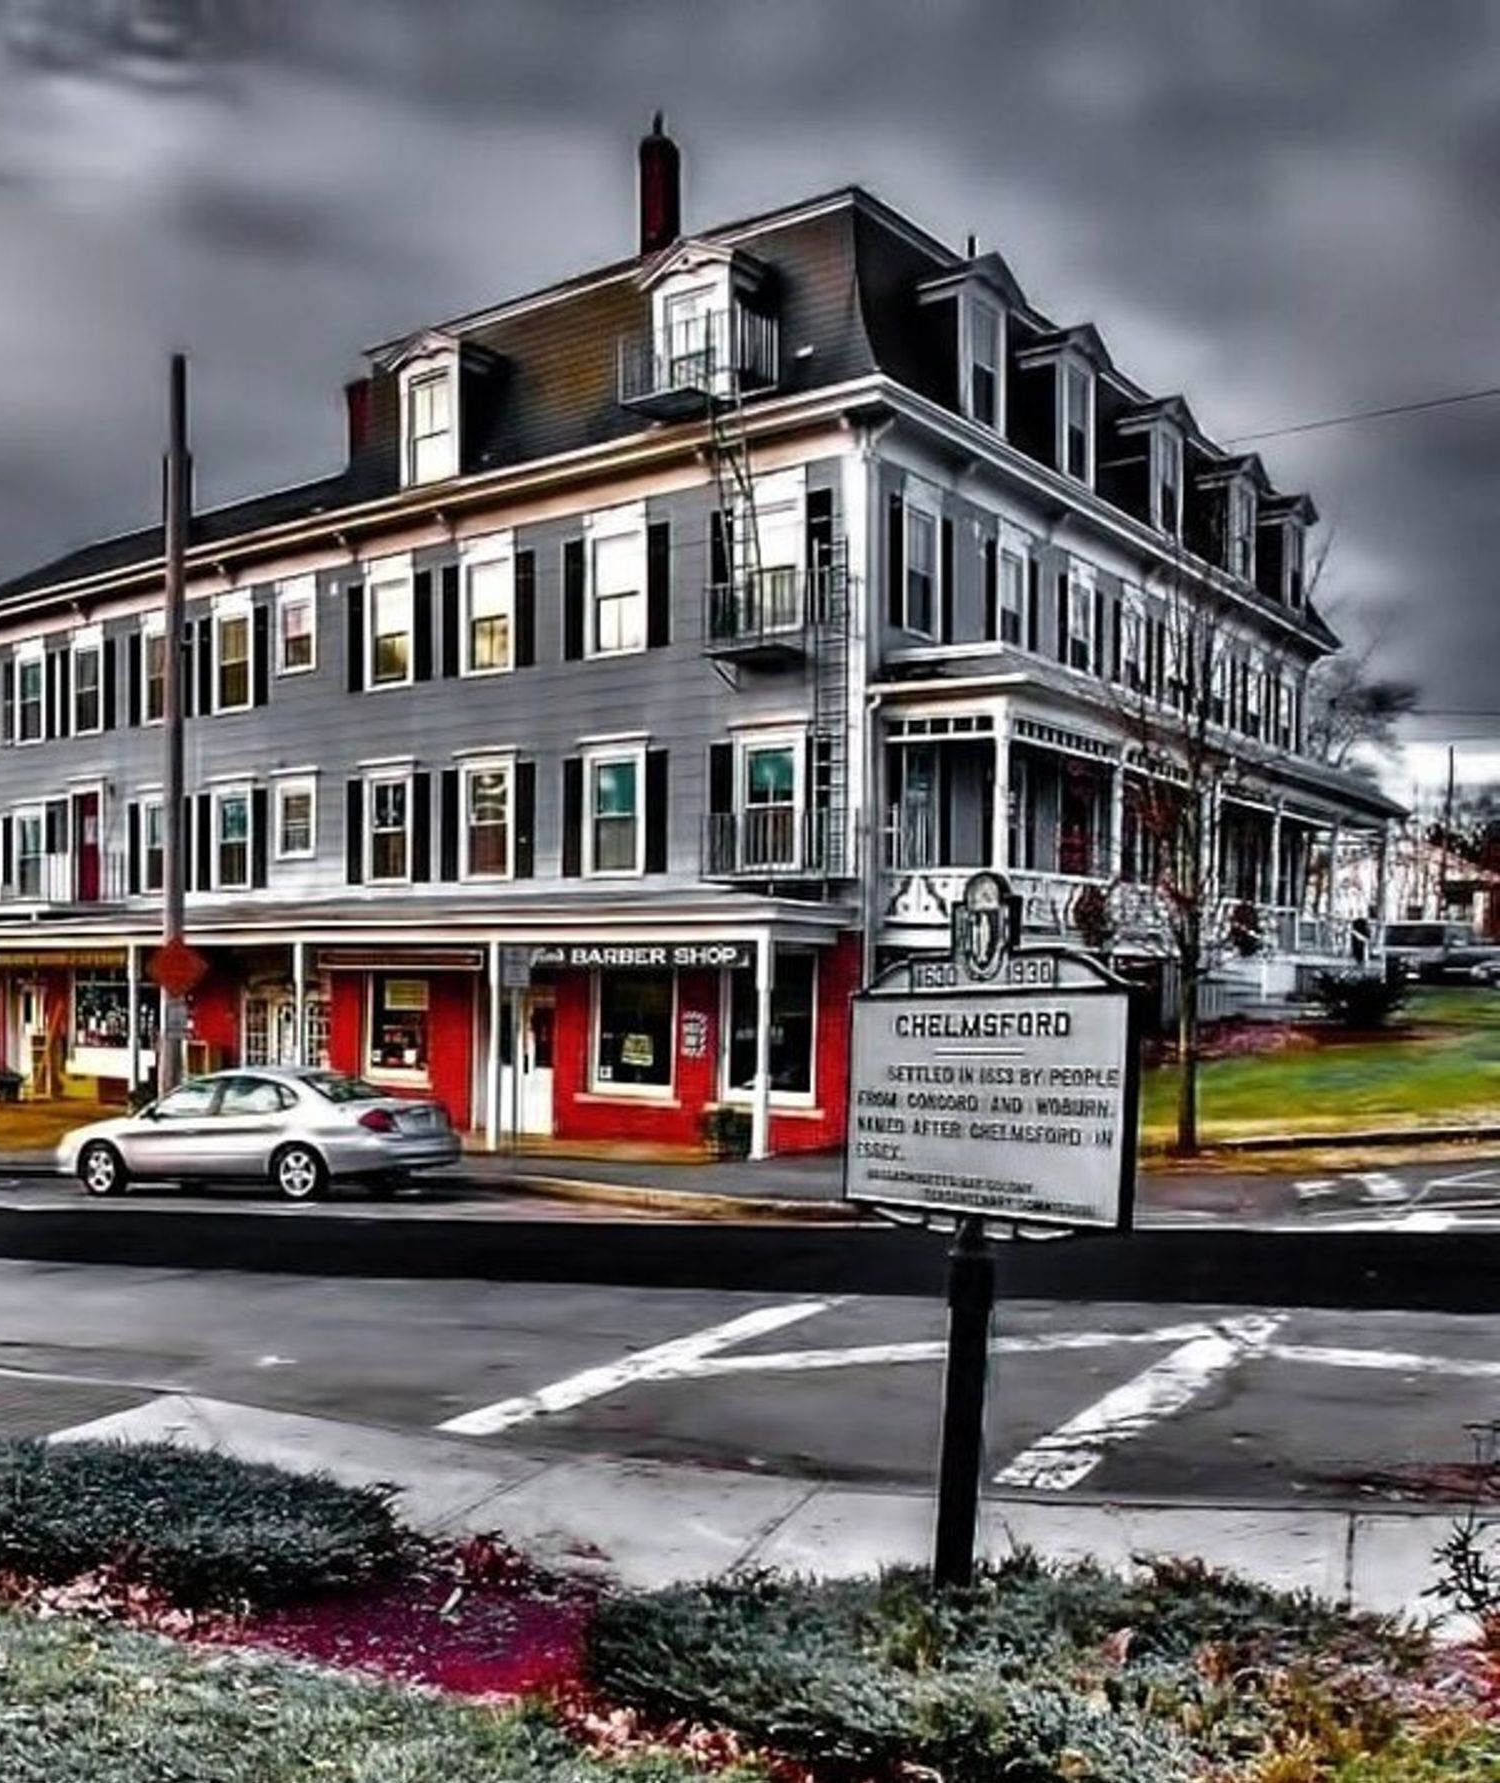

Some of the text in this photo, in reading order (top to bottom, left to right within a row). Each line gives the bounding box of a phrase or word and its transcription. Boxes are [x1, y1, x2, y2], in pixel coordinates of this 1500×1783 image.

[571, 947, 666, 964] BARBER
[673, 947, 737, 965] SHOP
[894, 1012, 1071, 1038] CHELMSFORD
[887, 1066, 953, 1085] SETTLED
[959, 1066, 973, 1085] IN
[1020, 1067, 1043, 1087] BY
[1050, 1067, 1119, 1089] PEOPLE
[858, 1090, 896, 1108] FROM
[907, 1092, 978, 1112] CONCORD
[990, 1096, 1022, 1114] AND
[912, 1119, 961, 1138] AFTER
[970, 1121, 1081, 1146] CHELMSFORD
[1094, 1128, 1113, 1149] IN
